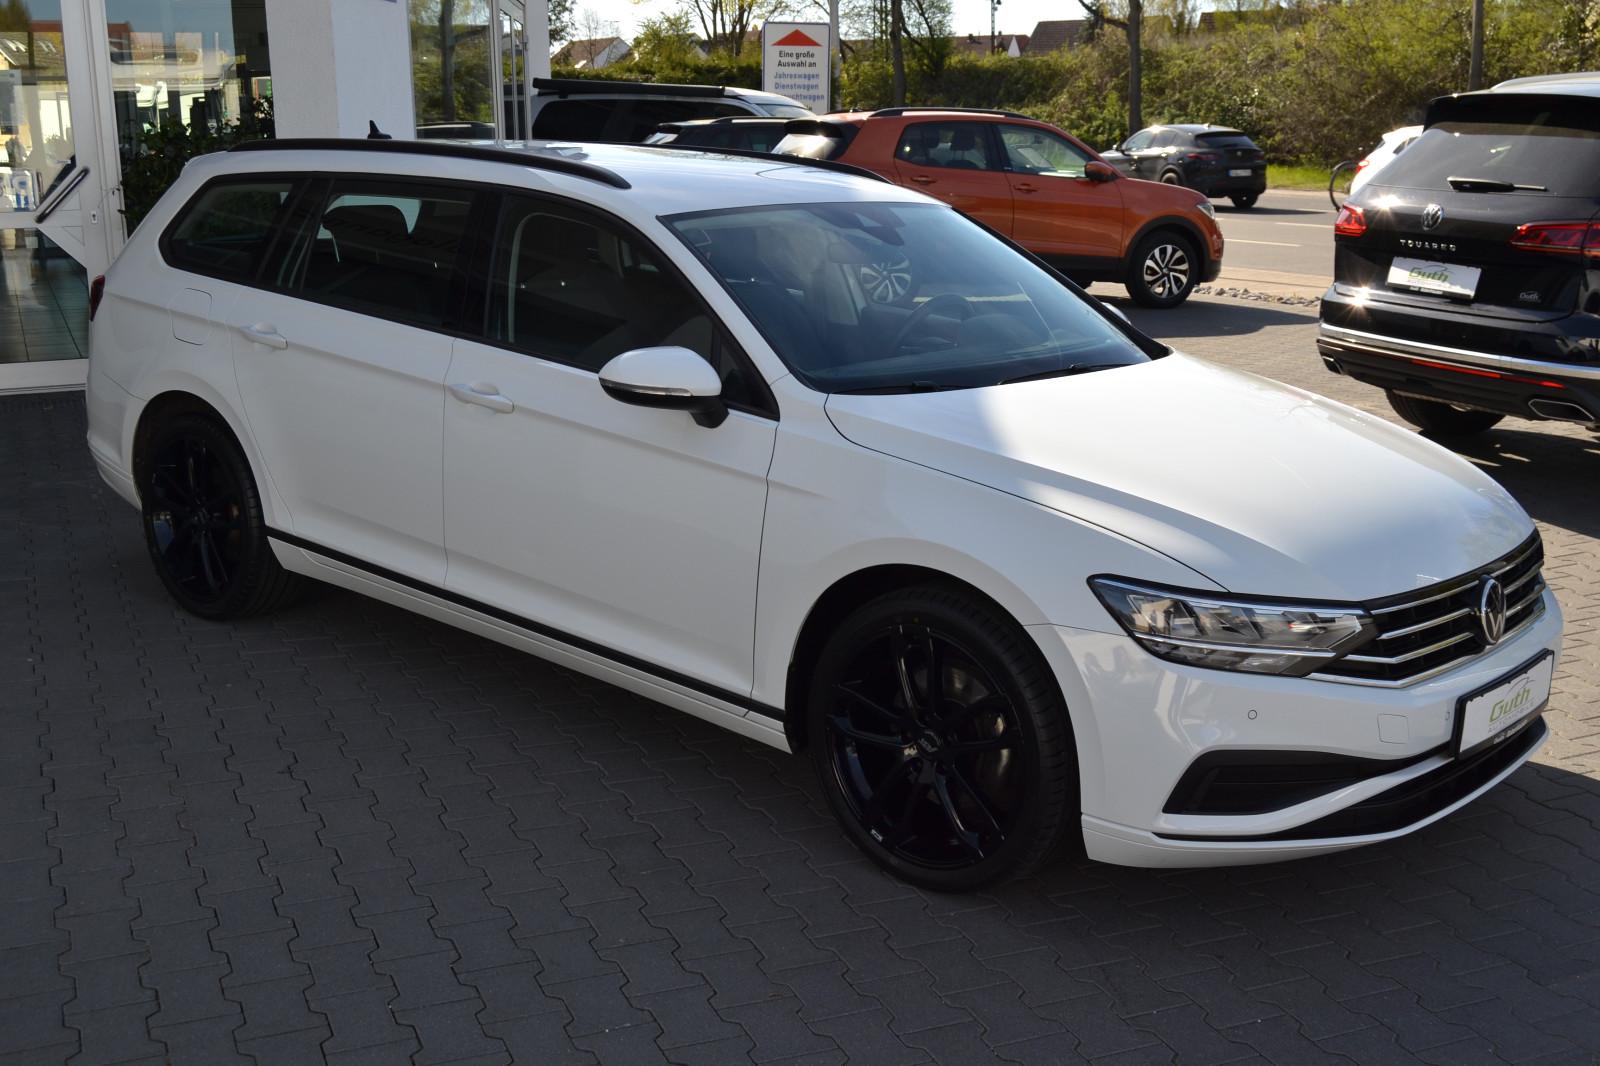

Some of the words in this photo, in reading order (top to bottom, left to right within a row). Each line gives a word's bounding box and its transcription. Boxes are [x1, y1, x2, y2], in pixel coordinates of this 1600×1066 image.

[795, 51, 815, 60] große
[777, 60, 807, 68] Auswahl
[774, 72, 820, 81] Jahreswagen
[774, 82, 819, 91] Dienstwagen
[783, 94, 825, 102] uchtwagen
[1400, 239, 1456, 251] TOUAREG
[1489, 688, 1531, 722] Guth
